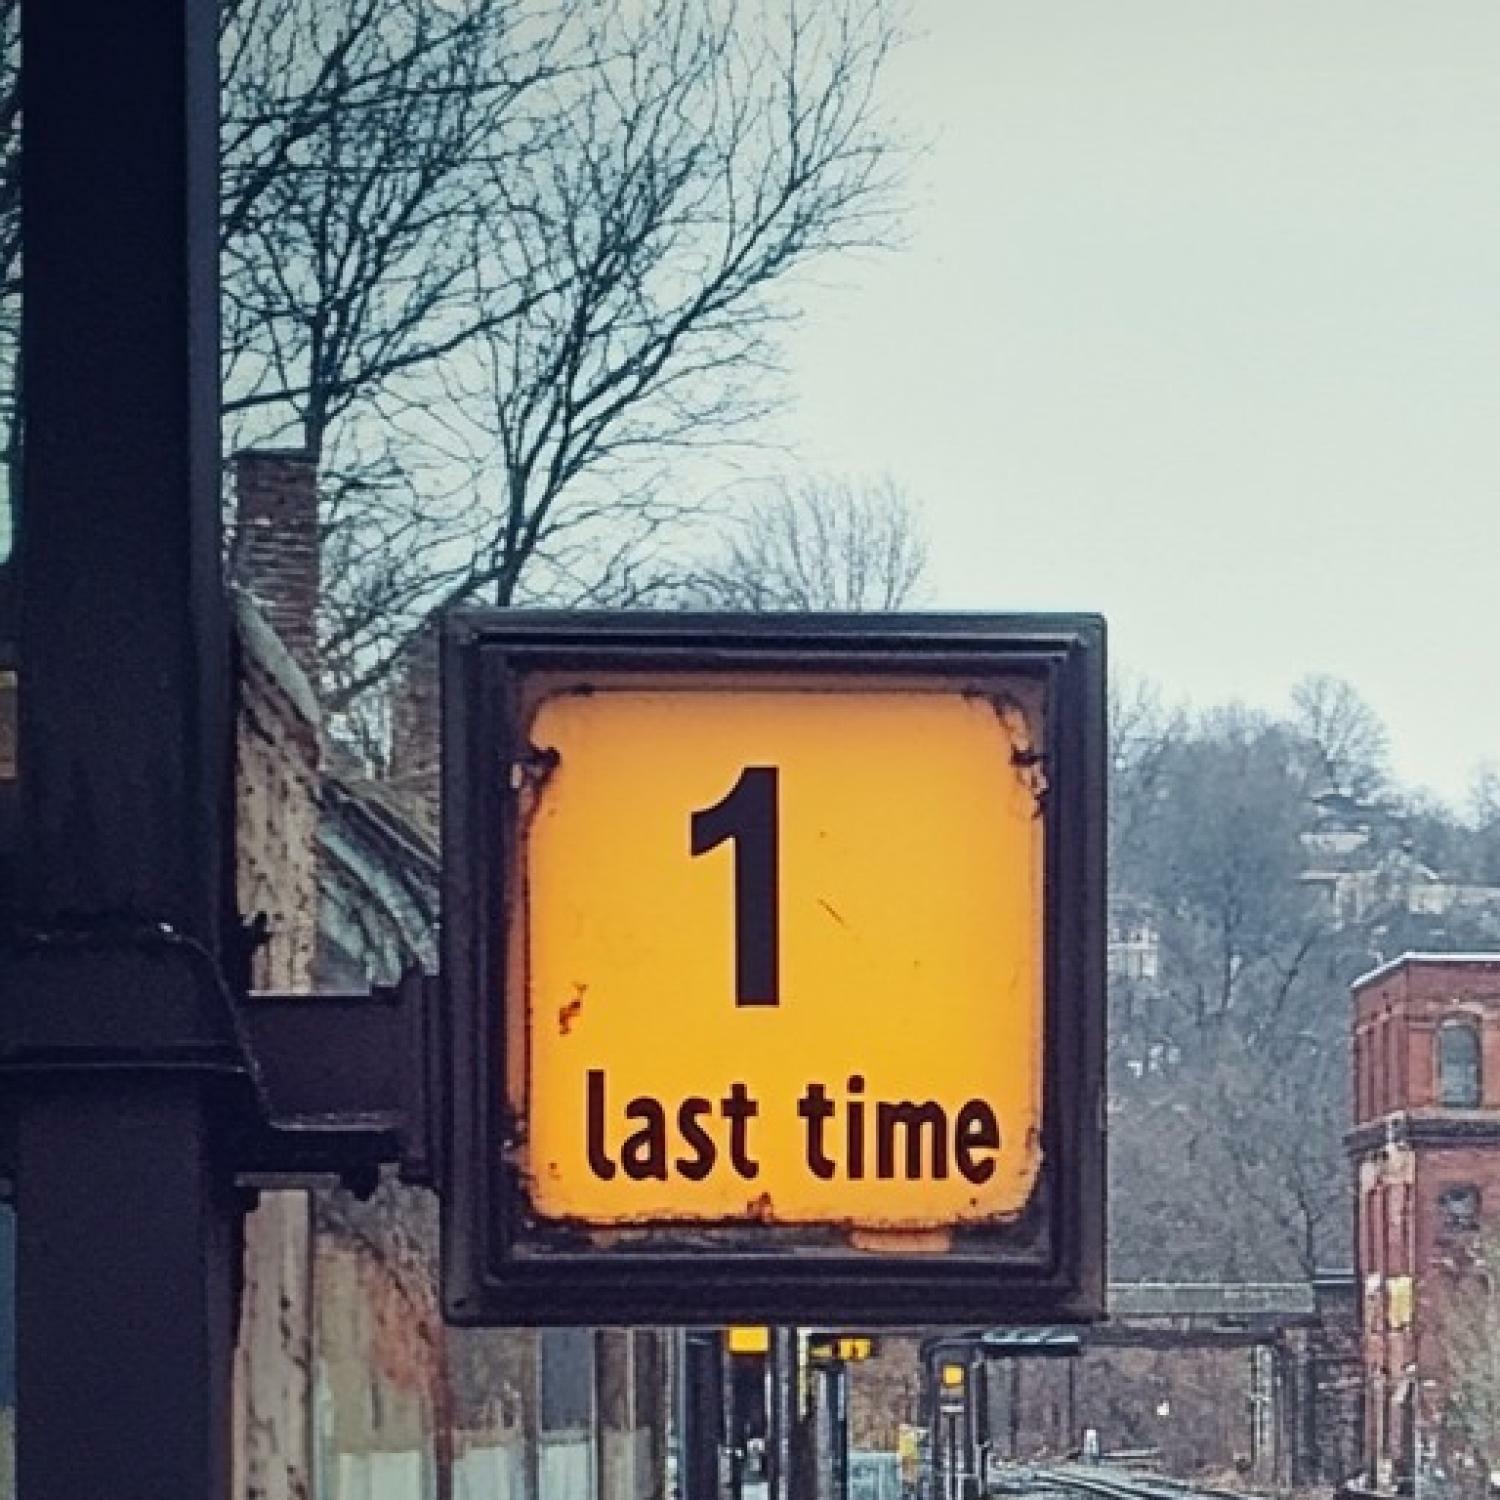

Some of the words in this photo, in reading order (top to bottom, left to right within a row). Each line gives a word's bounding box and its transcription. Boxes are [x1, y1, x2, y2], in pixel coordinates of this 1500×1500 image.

[690, 766, 780, 1008] 1
[587, 1069, 760, 1182] last
[797, 1074, 1000, 1185] time
